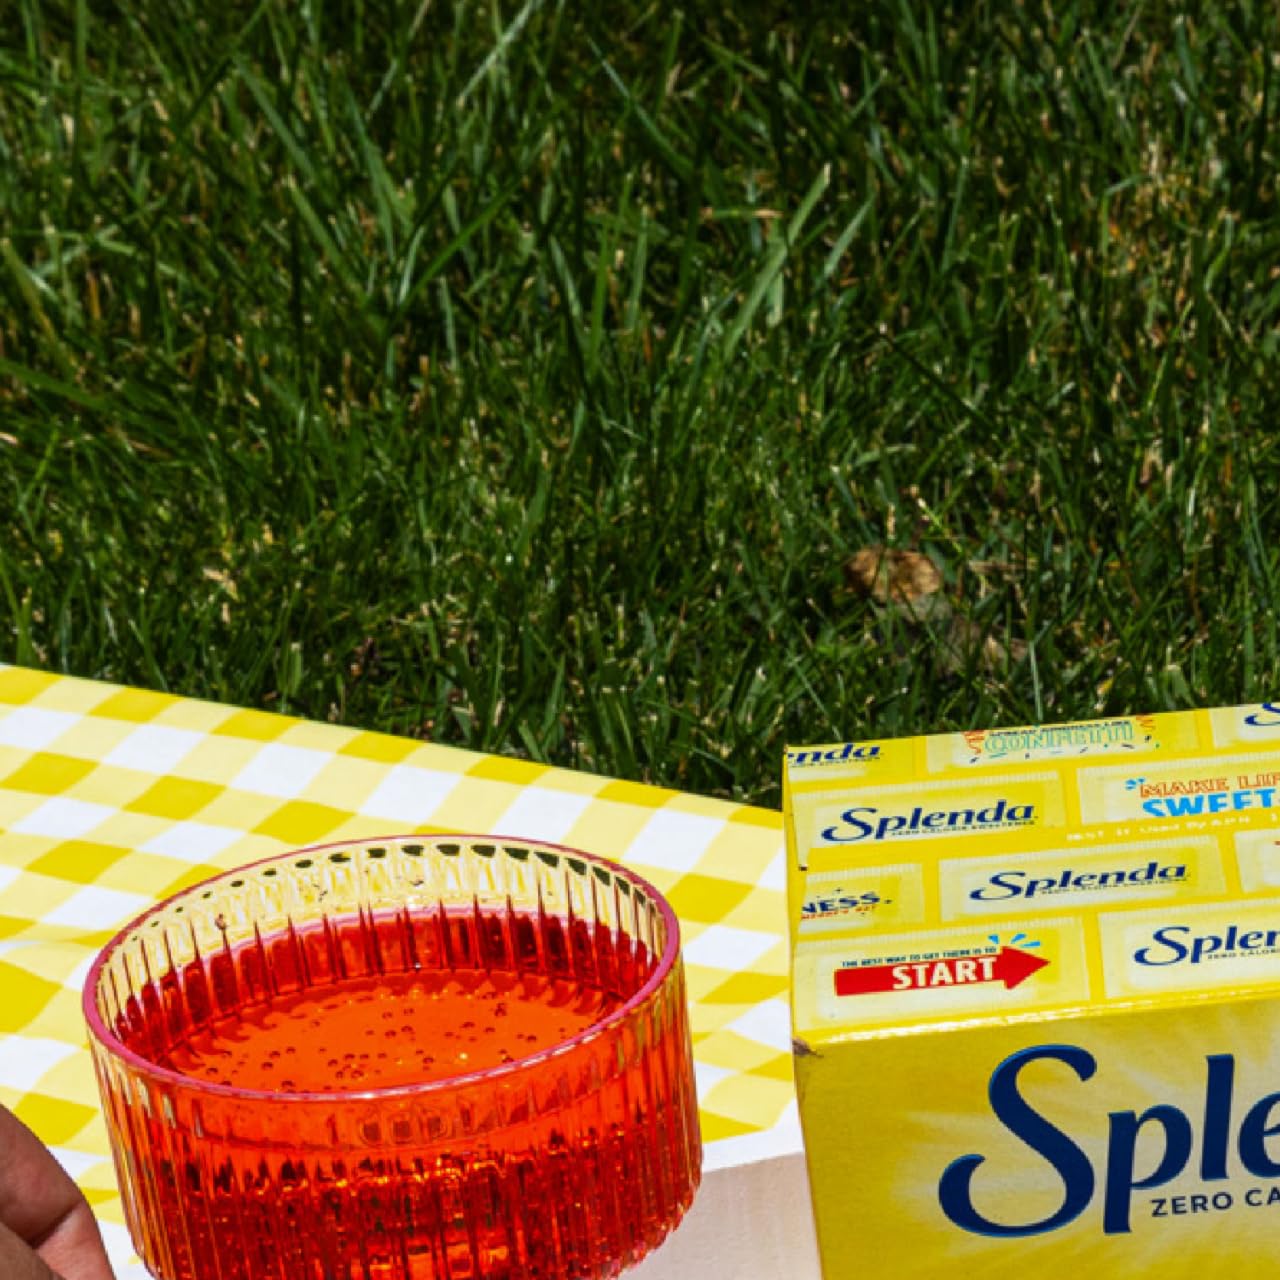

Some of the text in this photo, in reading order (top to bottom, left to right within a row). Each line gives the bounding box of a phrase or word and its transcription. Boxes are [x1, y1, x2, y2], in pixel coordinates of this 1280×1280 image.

[787, 742, 881, 764] nda
[1140, 778, 1230, 798] MAKE
[821, 800, 1037, 842] Splenda
[969, 861, 1187, 902] Splenda
[892, 956, 998, 990] START
[1151, 1190, 1233, 1218] ZERO
